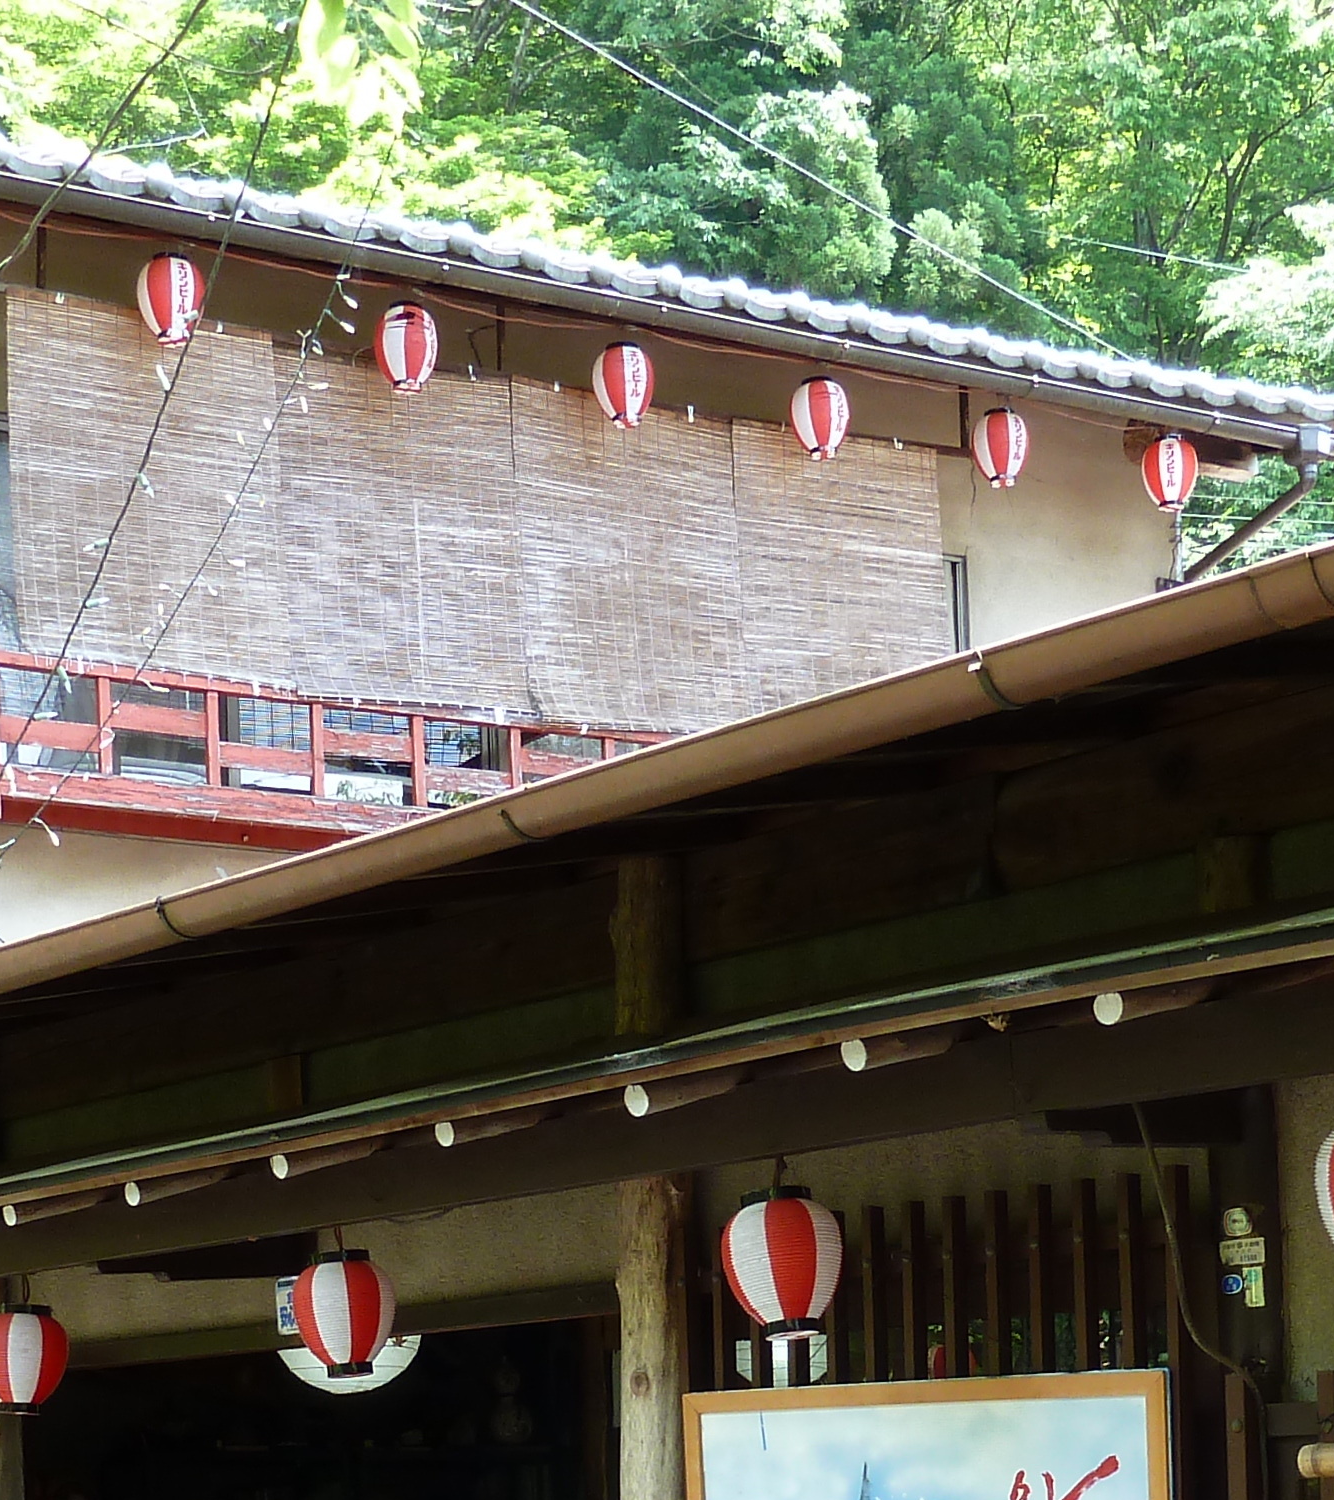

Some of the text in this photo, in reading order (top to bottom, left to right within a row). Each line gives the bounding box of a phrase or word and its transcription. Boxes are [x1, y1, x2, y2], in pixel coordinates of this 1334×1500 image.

[175, 261, 189, 315] キリンビール
[628, 350, 642, 398] キリンビール
[1164, 442, 1177, 488] キリンビール
